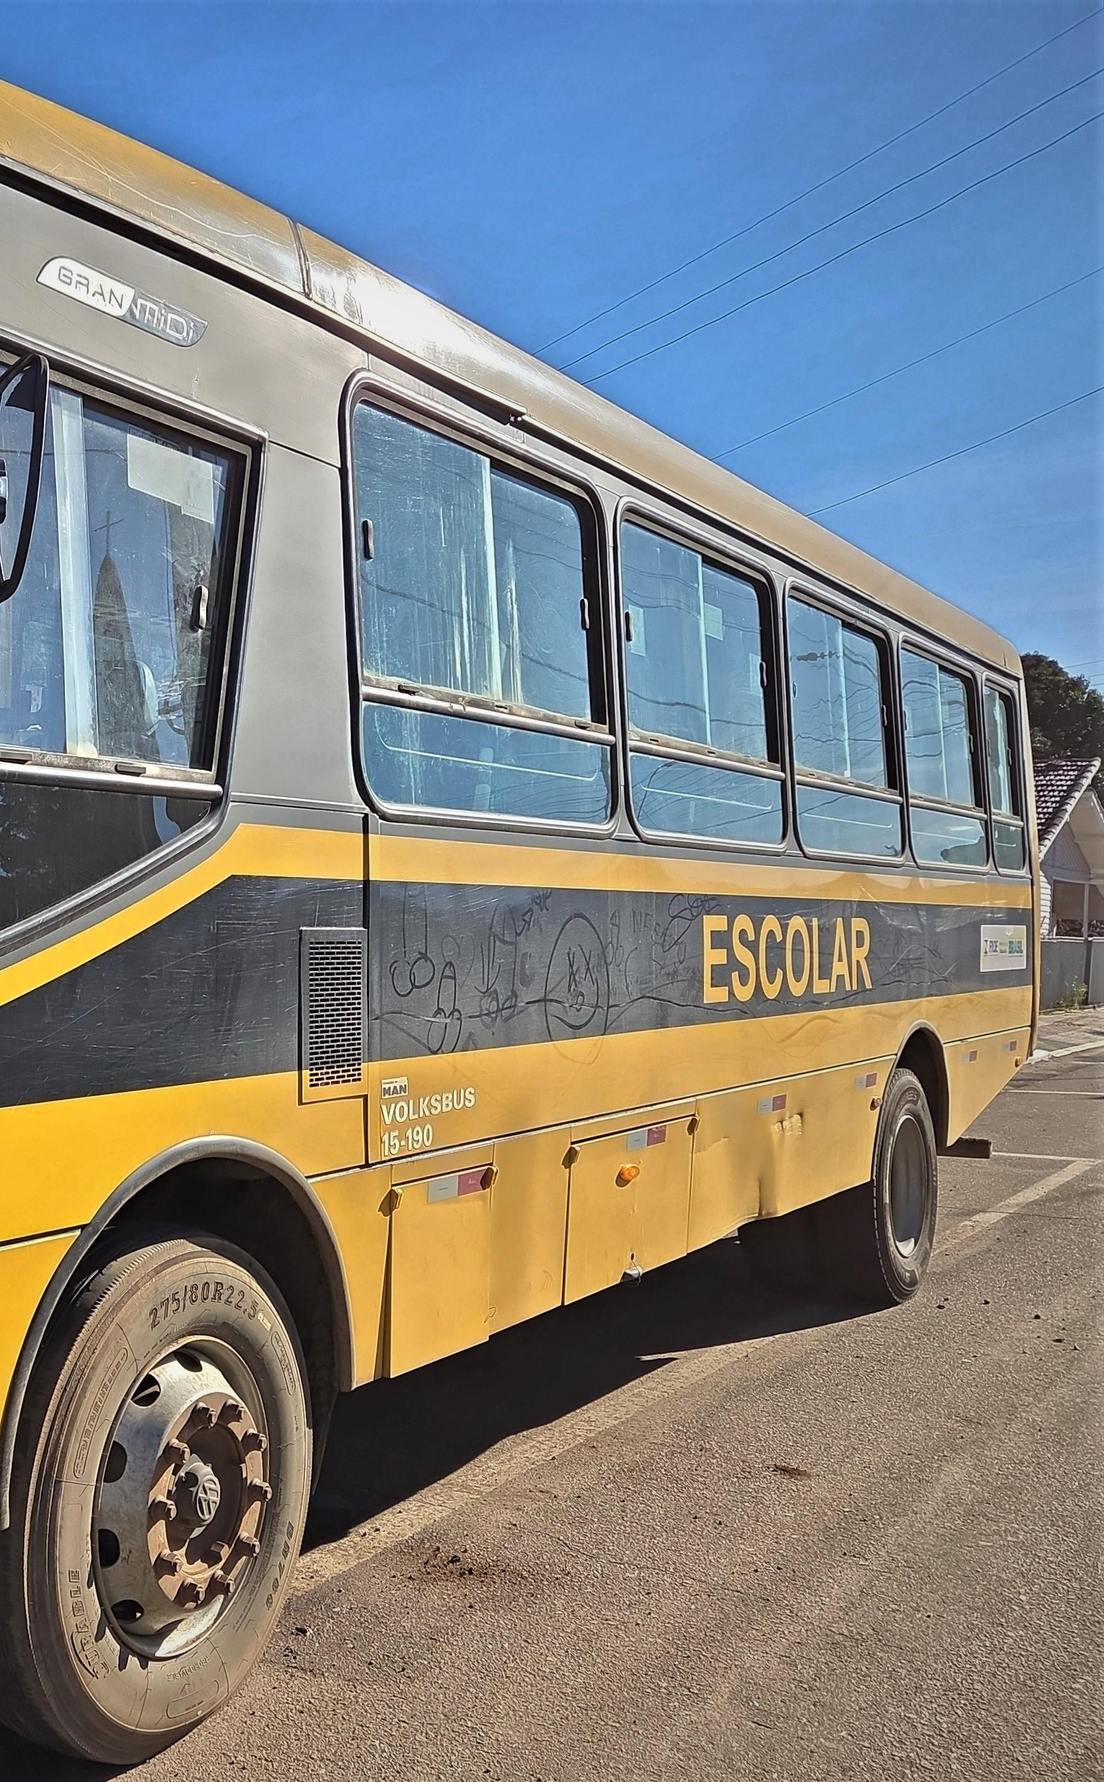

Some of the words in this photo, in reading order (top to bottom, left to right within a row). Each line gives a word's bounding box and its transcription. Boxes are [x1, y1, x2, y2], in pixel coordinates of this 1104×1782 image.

[57, 265, 125, 310] GRAN
[701, 913, 873, 1004] ESCOLAR
[380, 1086, 476, 1126] VOLKSBUS
[382, 1084, 407, 1098] MAN
[381, 1122, 434, 1156] 15-190
[147, 1280, 260, 1332] 275/80R22.5
